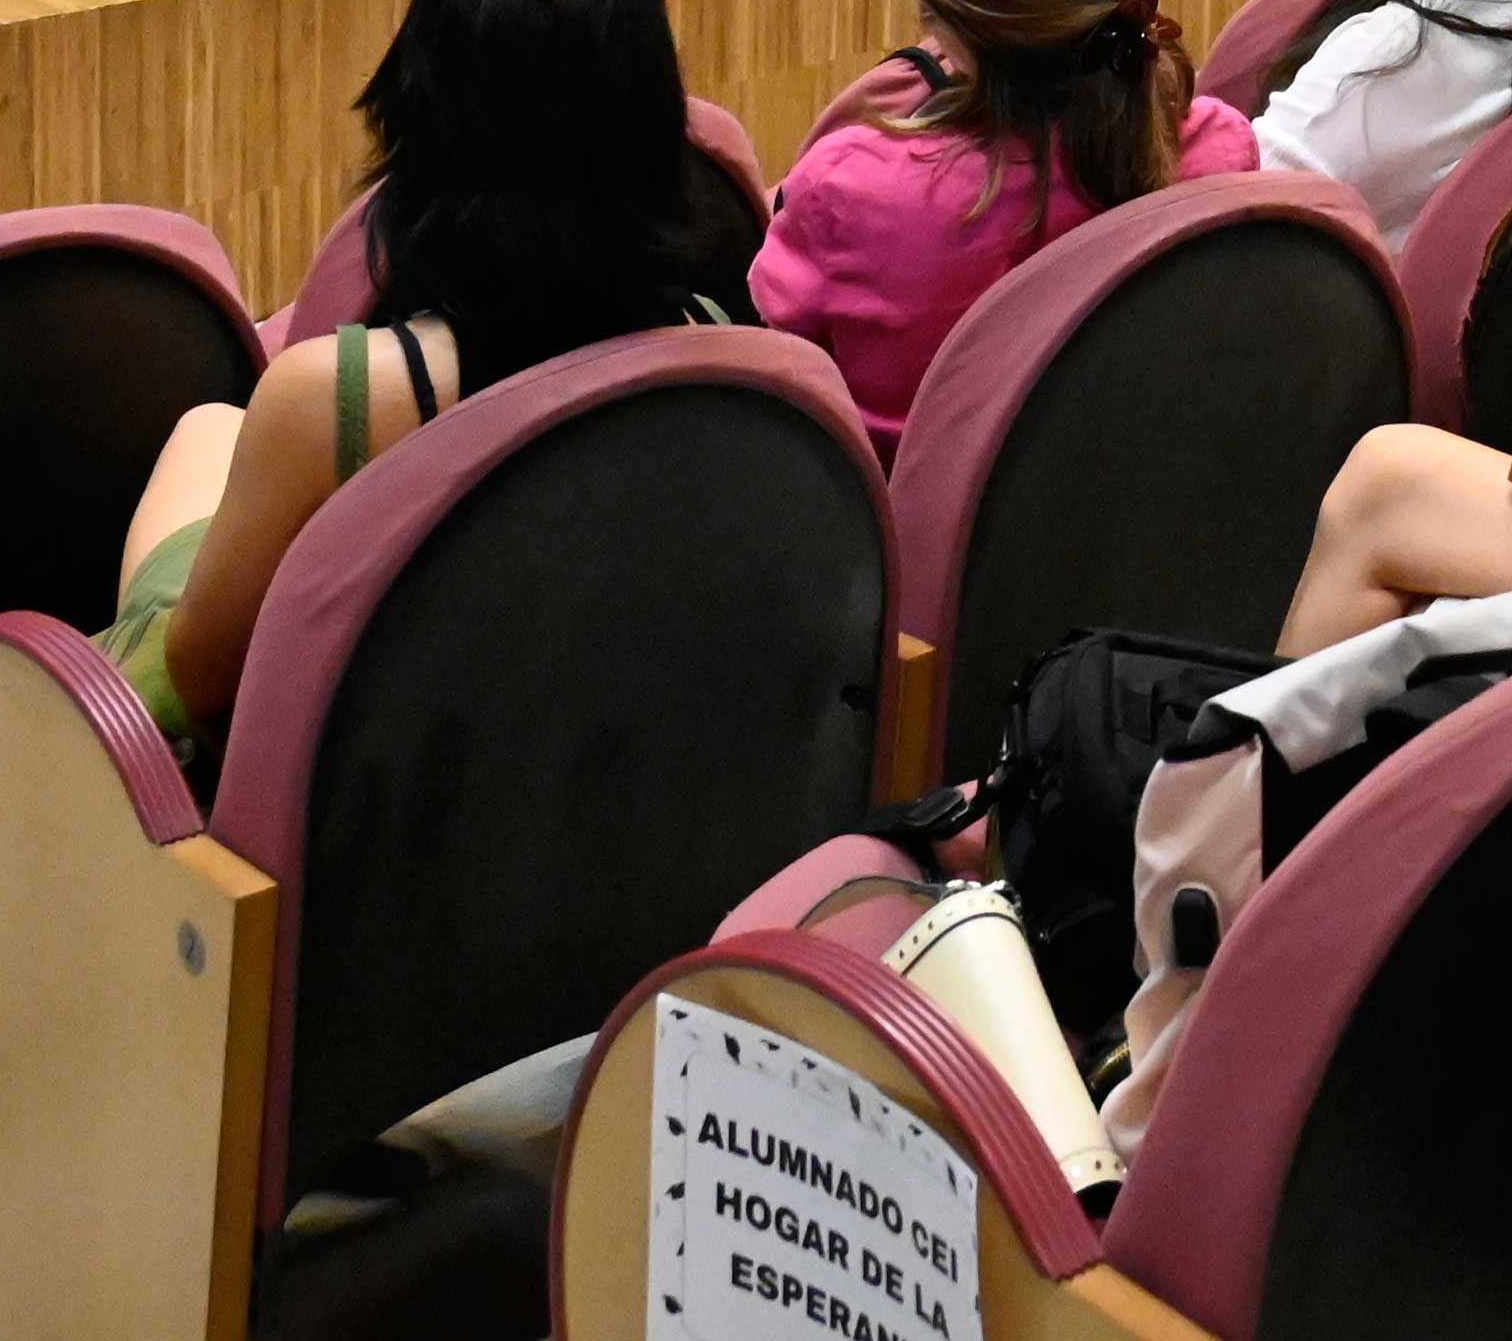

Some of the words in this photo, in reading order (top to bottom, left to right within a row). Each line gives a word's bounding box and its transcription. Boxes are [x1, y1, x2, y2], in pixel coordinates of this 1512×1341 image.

[697, 1112, 904, 1234] ALUMNADO
[910, 1219, 959, 1283] CEI
[715, 1181, 849, 1270] HOGAR
[861, 1247, 904, 1304] DE
[914, 1282, 951, 1340] LA
